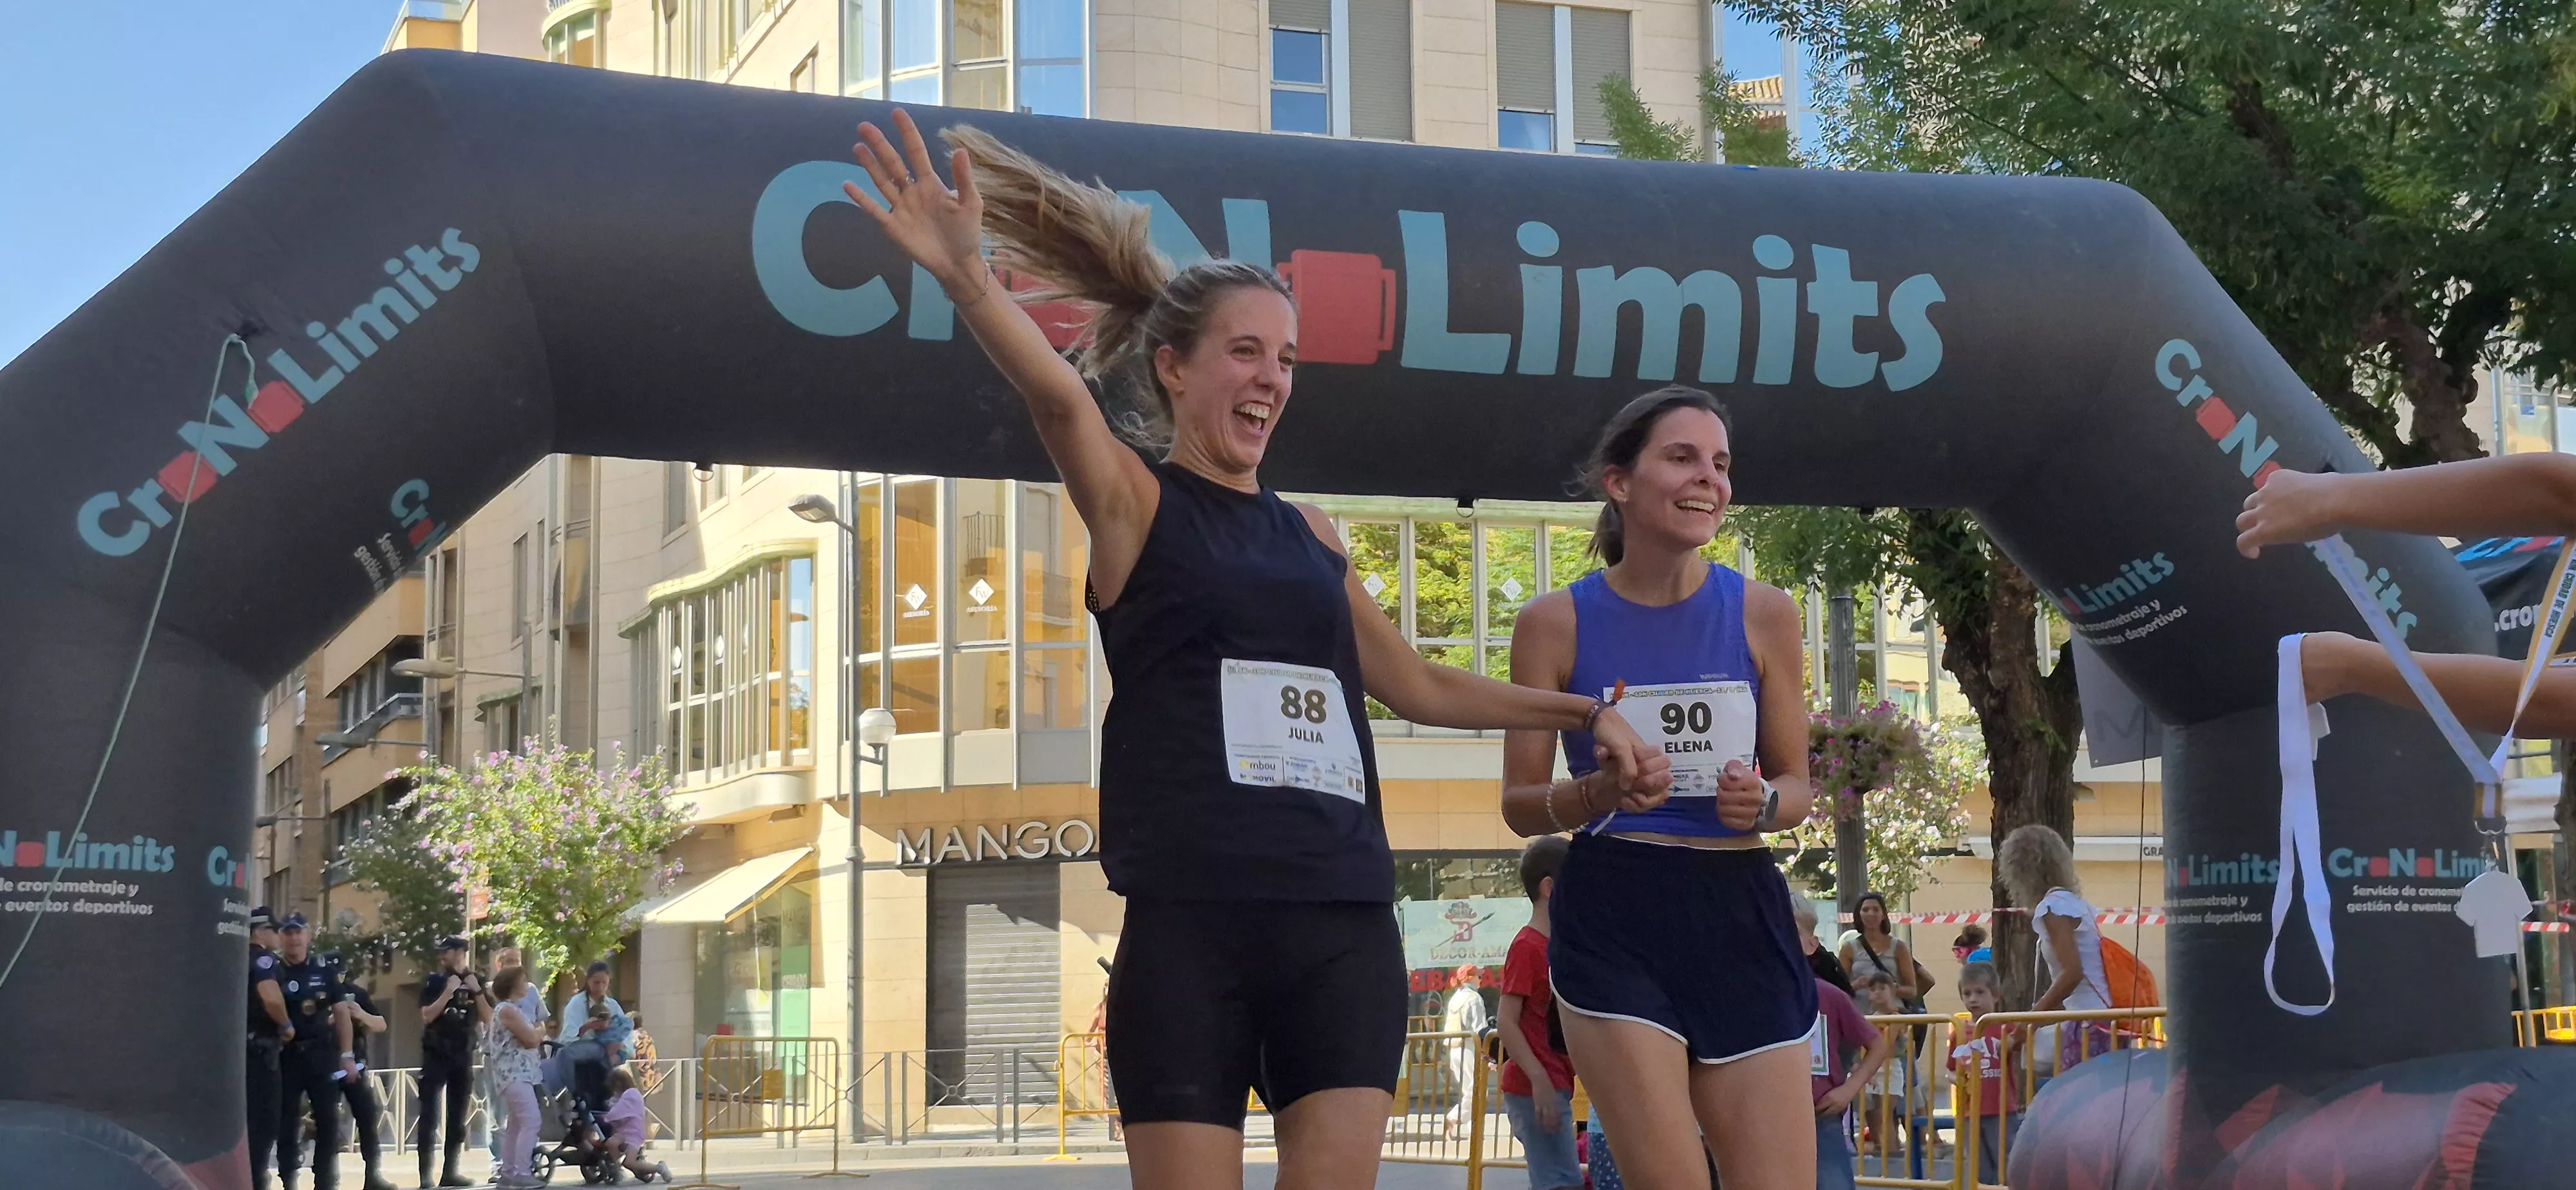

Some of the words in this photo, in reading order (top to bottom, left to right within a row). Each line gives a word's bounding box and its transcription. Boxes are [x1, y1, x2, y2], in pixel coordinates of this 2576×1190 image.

[2149, 599, 2160, 611] y
[2125, 605, 2188, 640] deportivos
[1280, 685, 1327, 724] 88
[1660, 701, 1712, 735] 90
[1288, 726, 1324, 744] JULIA
[1664, 740, 1714, 754] ELENA
[896, 819, 1095, 865] MANGO
[17, 880, 126, 896] cronometraje
[128, 883, 140, 898] y
[2352, 884, 2400, 896] Servicio
[2401, 884, 2416, 896] de
[5, 900, 70, 914] eventos
[73, 898, 154, 916] deportivos
[2240, 896, 2249, 908] y
[2347, 900, 2392, 914] gestión
[2394, 900, 2410, 912] de
[2411, 902, 2452, 913] eventos
[2203, 911, 2263, 925] deportivos
